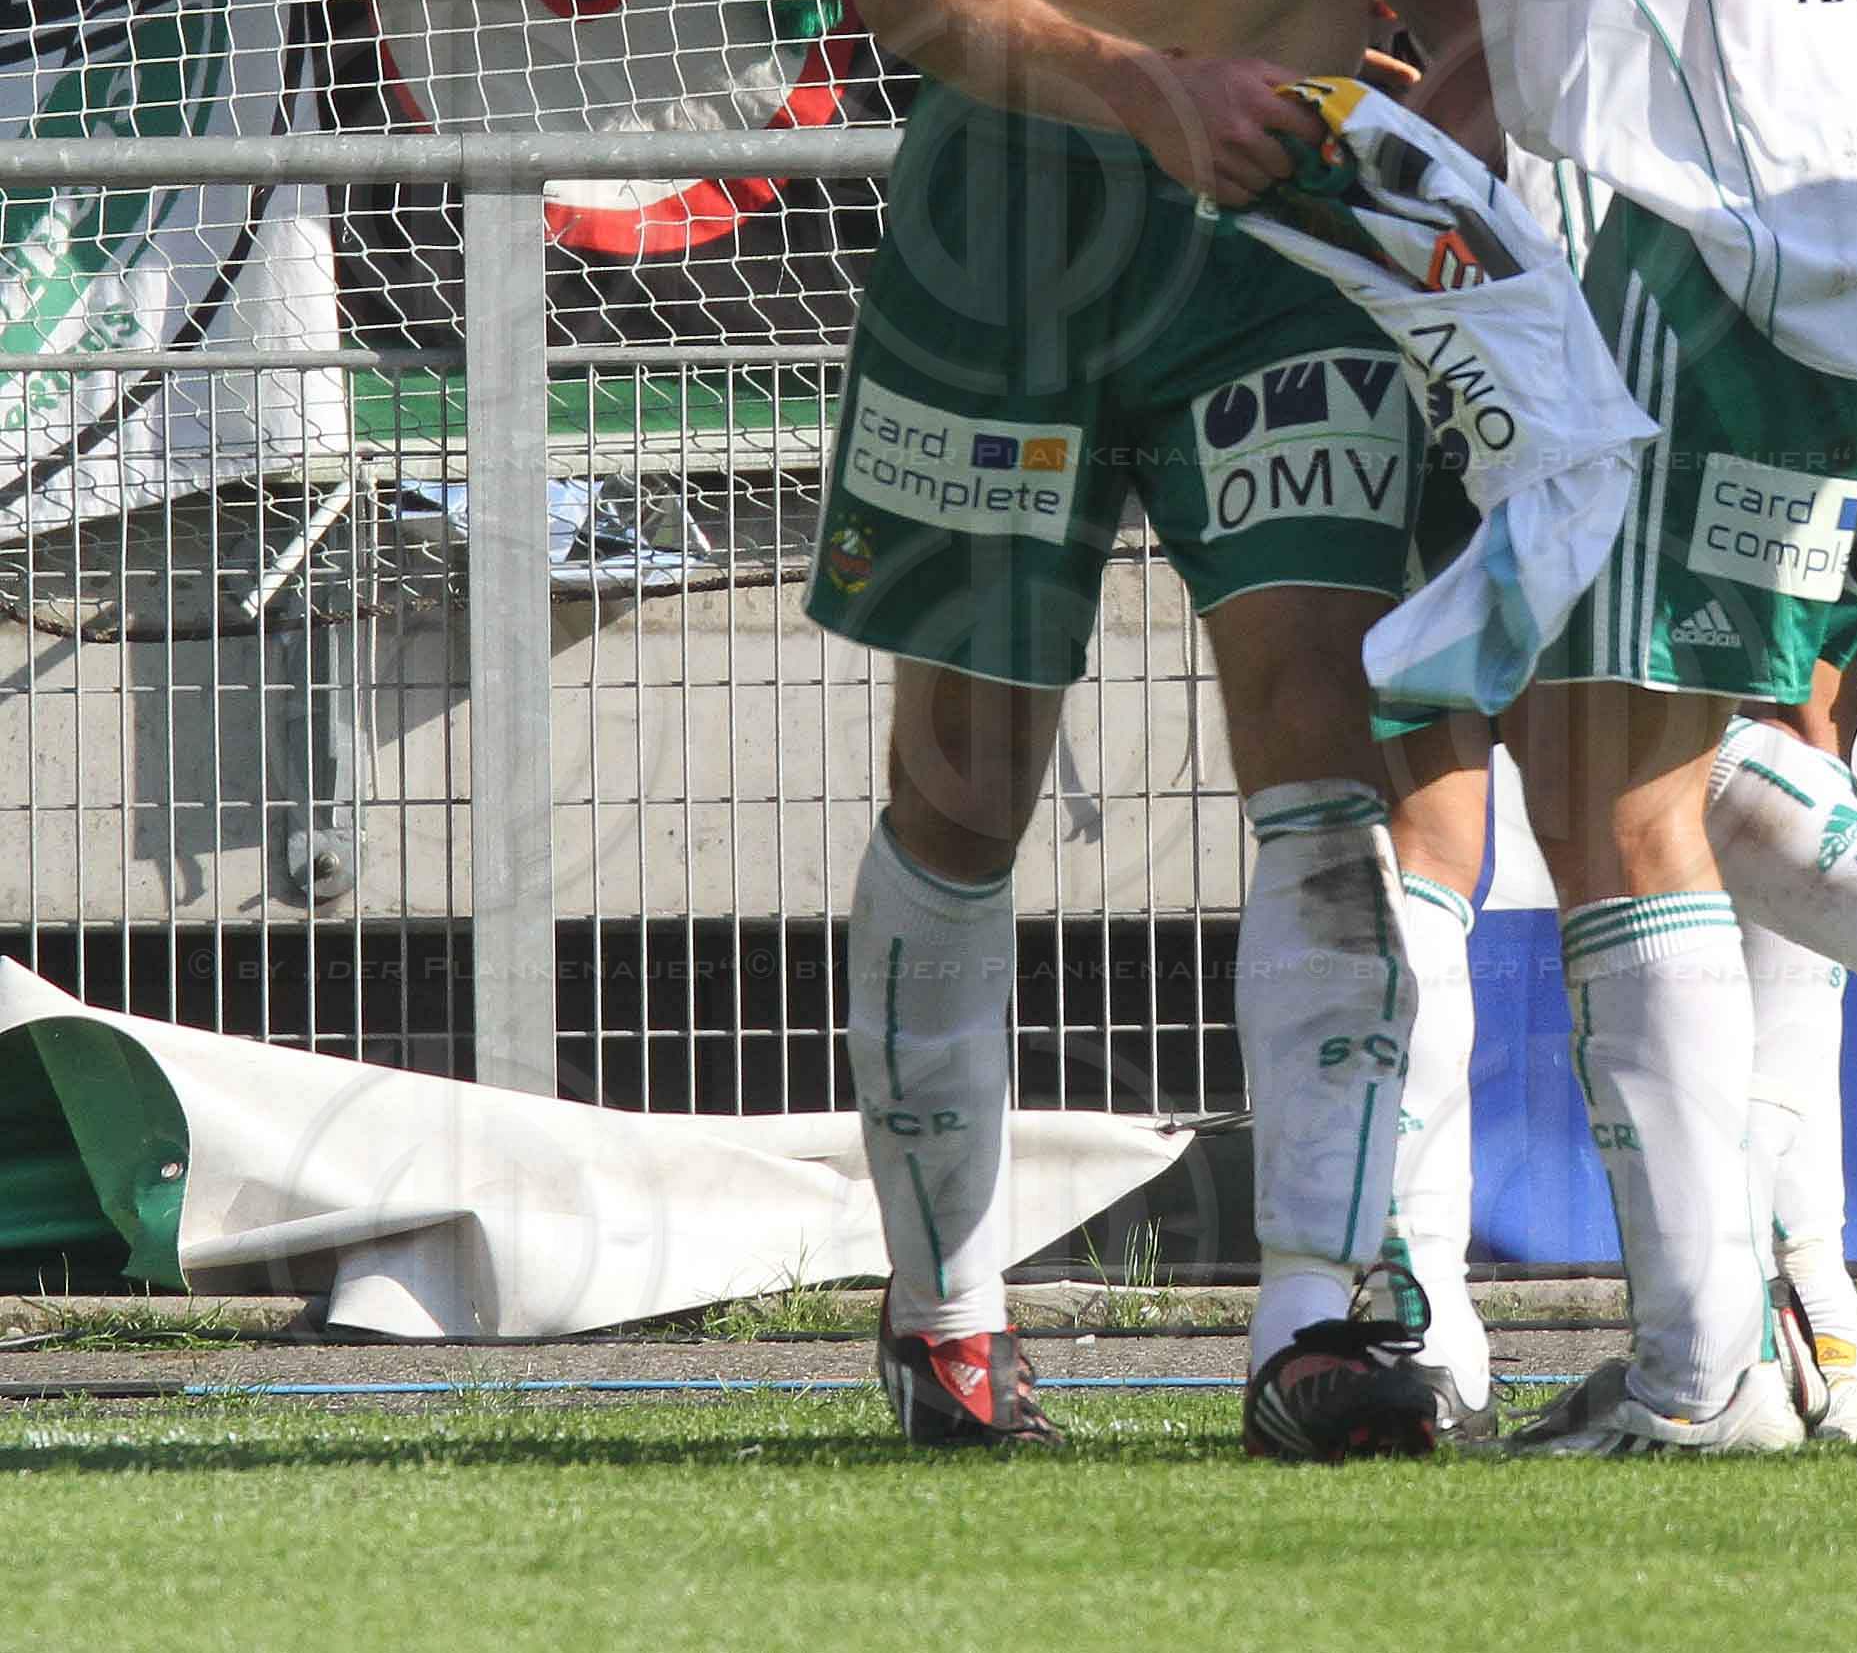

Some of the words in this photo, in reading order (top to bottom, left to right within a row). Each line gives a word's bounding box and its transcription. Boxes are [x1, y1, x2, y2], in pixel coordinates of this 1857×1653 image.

[860, 406, 949, 459] card
[852, 447, 1062, 516] complete
[1218, 448, 1399, 530] OMV
[1714, 480, 1817, 525] card
[1671, 627, 1742, 647] adidas
